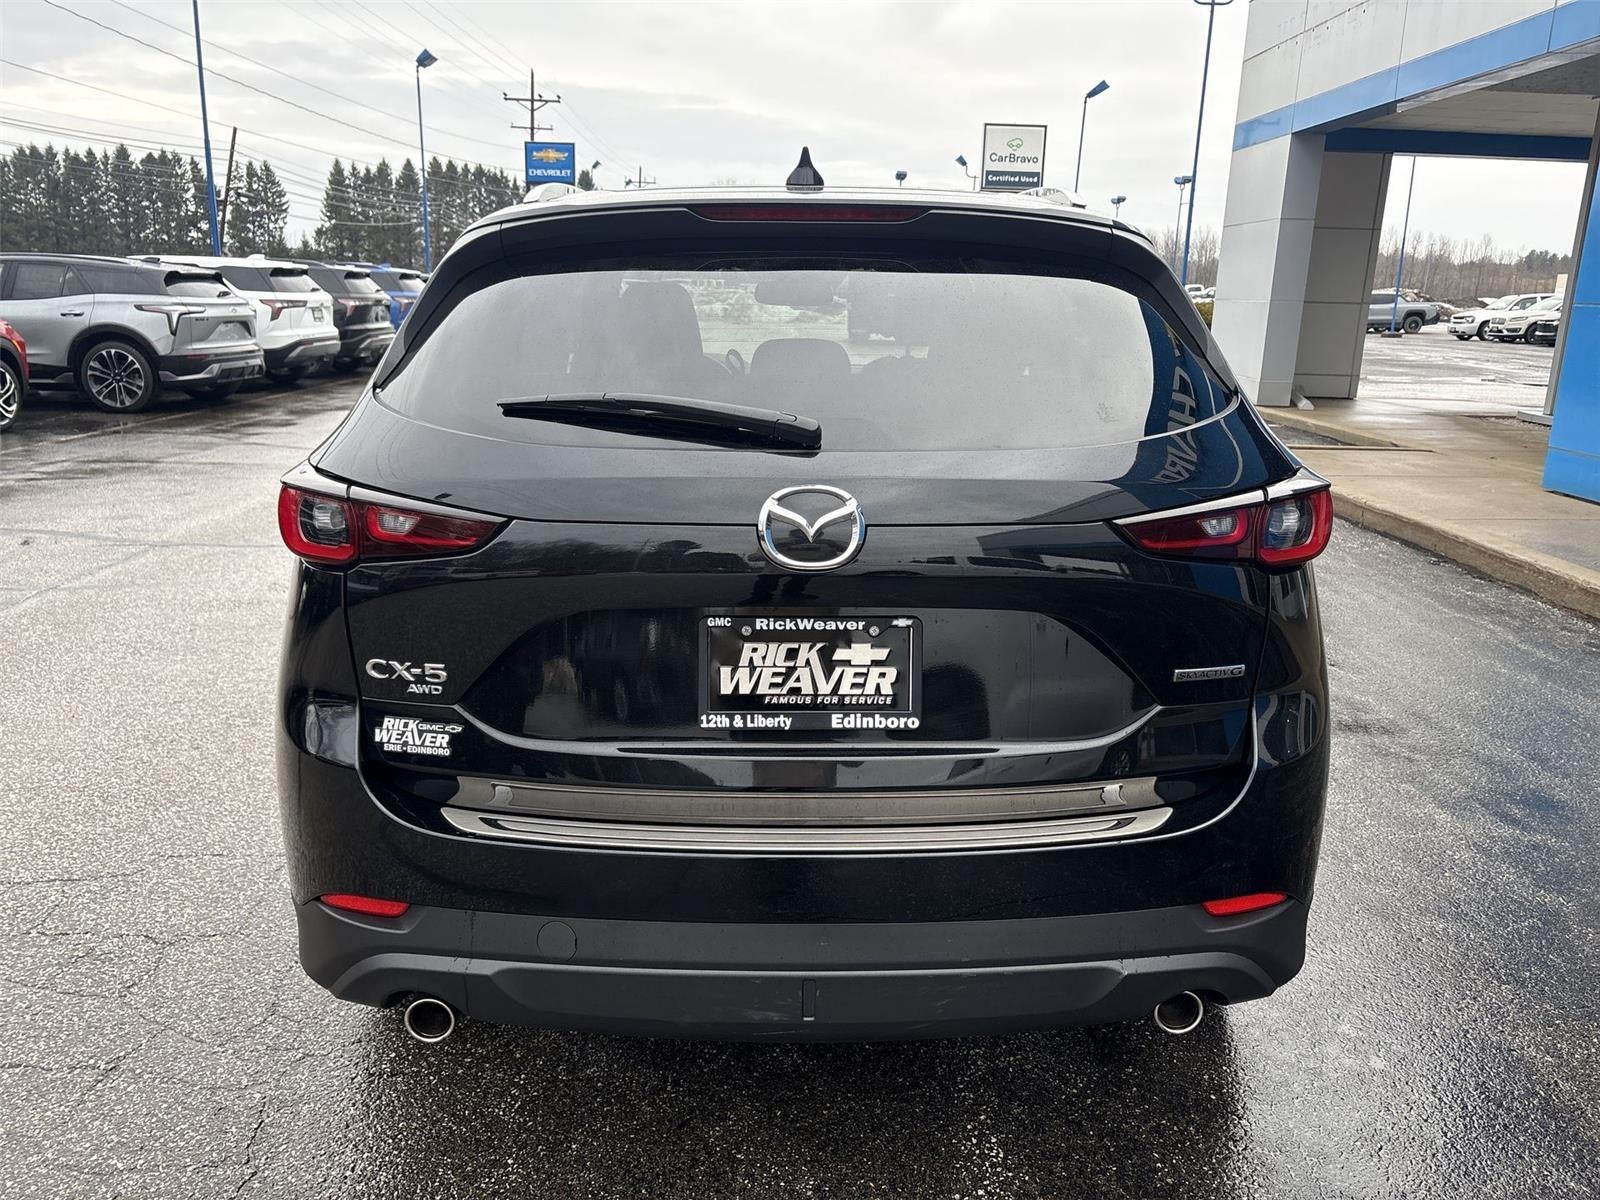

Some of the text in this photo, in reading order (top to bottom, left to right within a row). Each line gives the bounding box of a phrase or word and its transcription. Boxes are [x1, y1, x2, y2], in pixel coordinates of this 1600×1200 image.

[989, 152, 1039, 164] CarBravo
[528, 168, 571, 177] CHEVROLET
[987, 174, 1038, 183] Certified Used
[707, 617, 732, 627] GMC
[739, 642, 827, 668] RICK
[365, 658, 448, 683] CX-5
[719, 666, 898, 696] WEAVER
[407, 683, 443, 695] AWD
[764, 695, 893, 705] FAMOUS FOR SERVICE
[382, 716, 420, 732] RICK
[418, 723, 444, 732] GMC
[700, 714, 793, 730] 12th & Liberty
[831, 713, 920, 729] Edinboro
[374, 728, 450, 748] WEAVER
